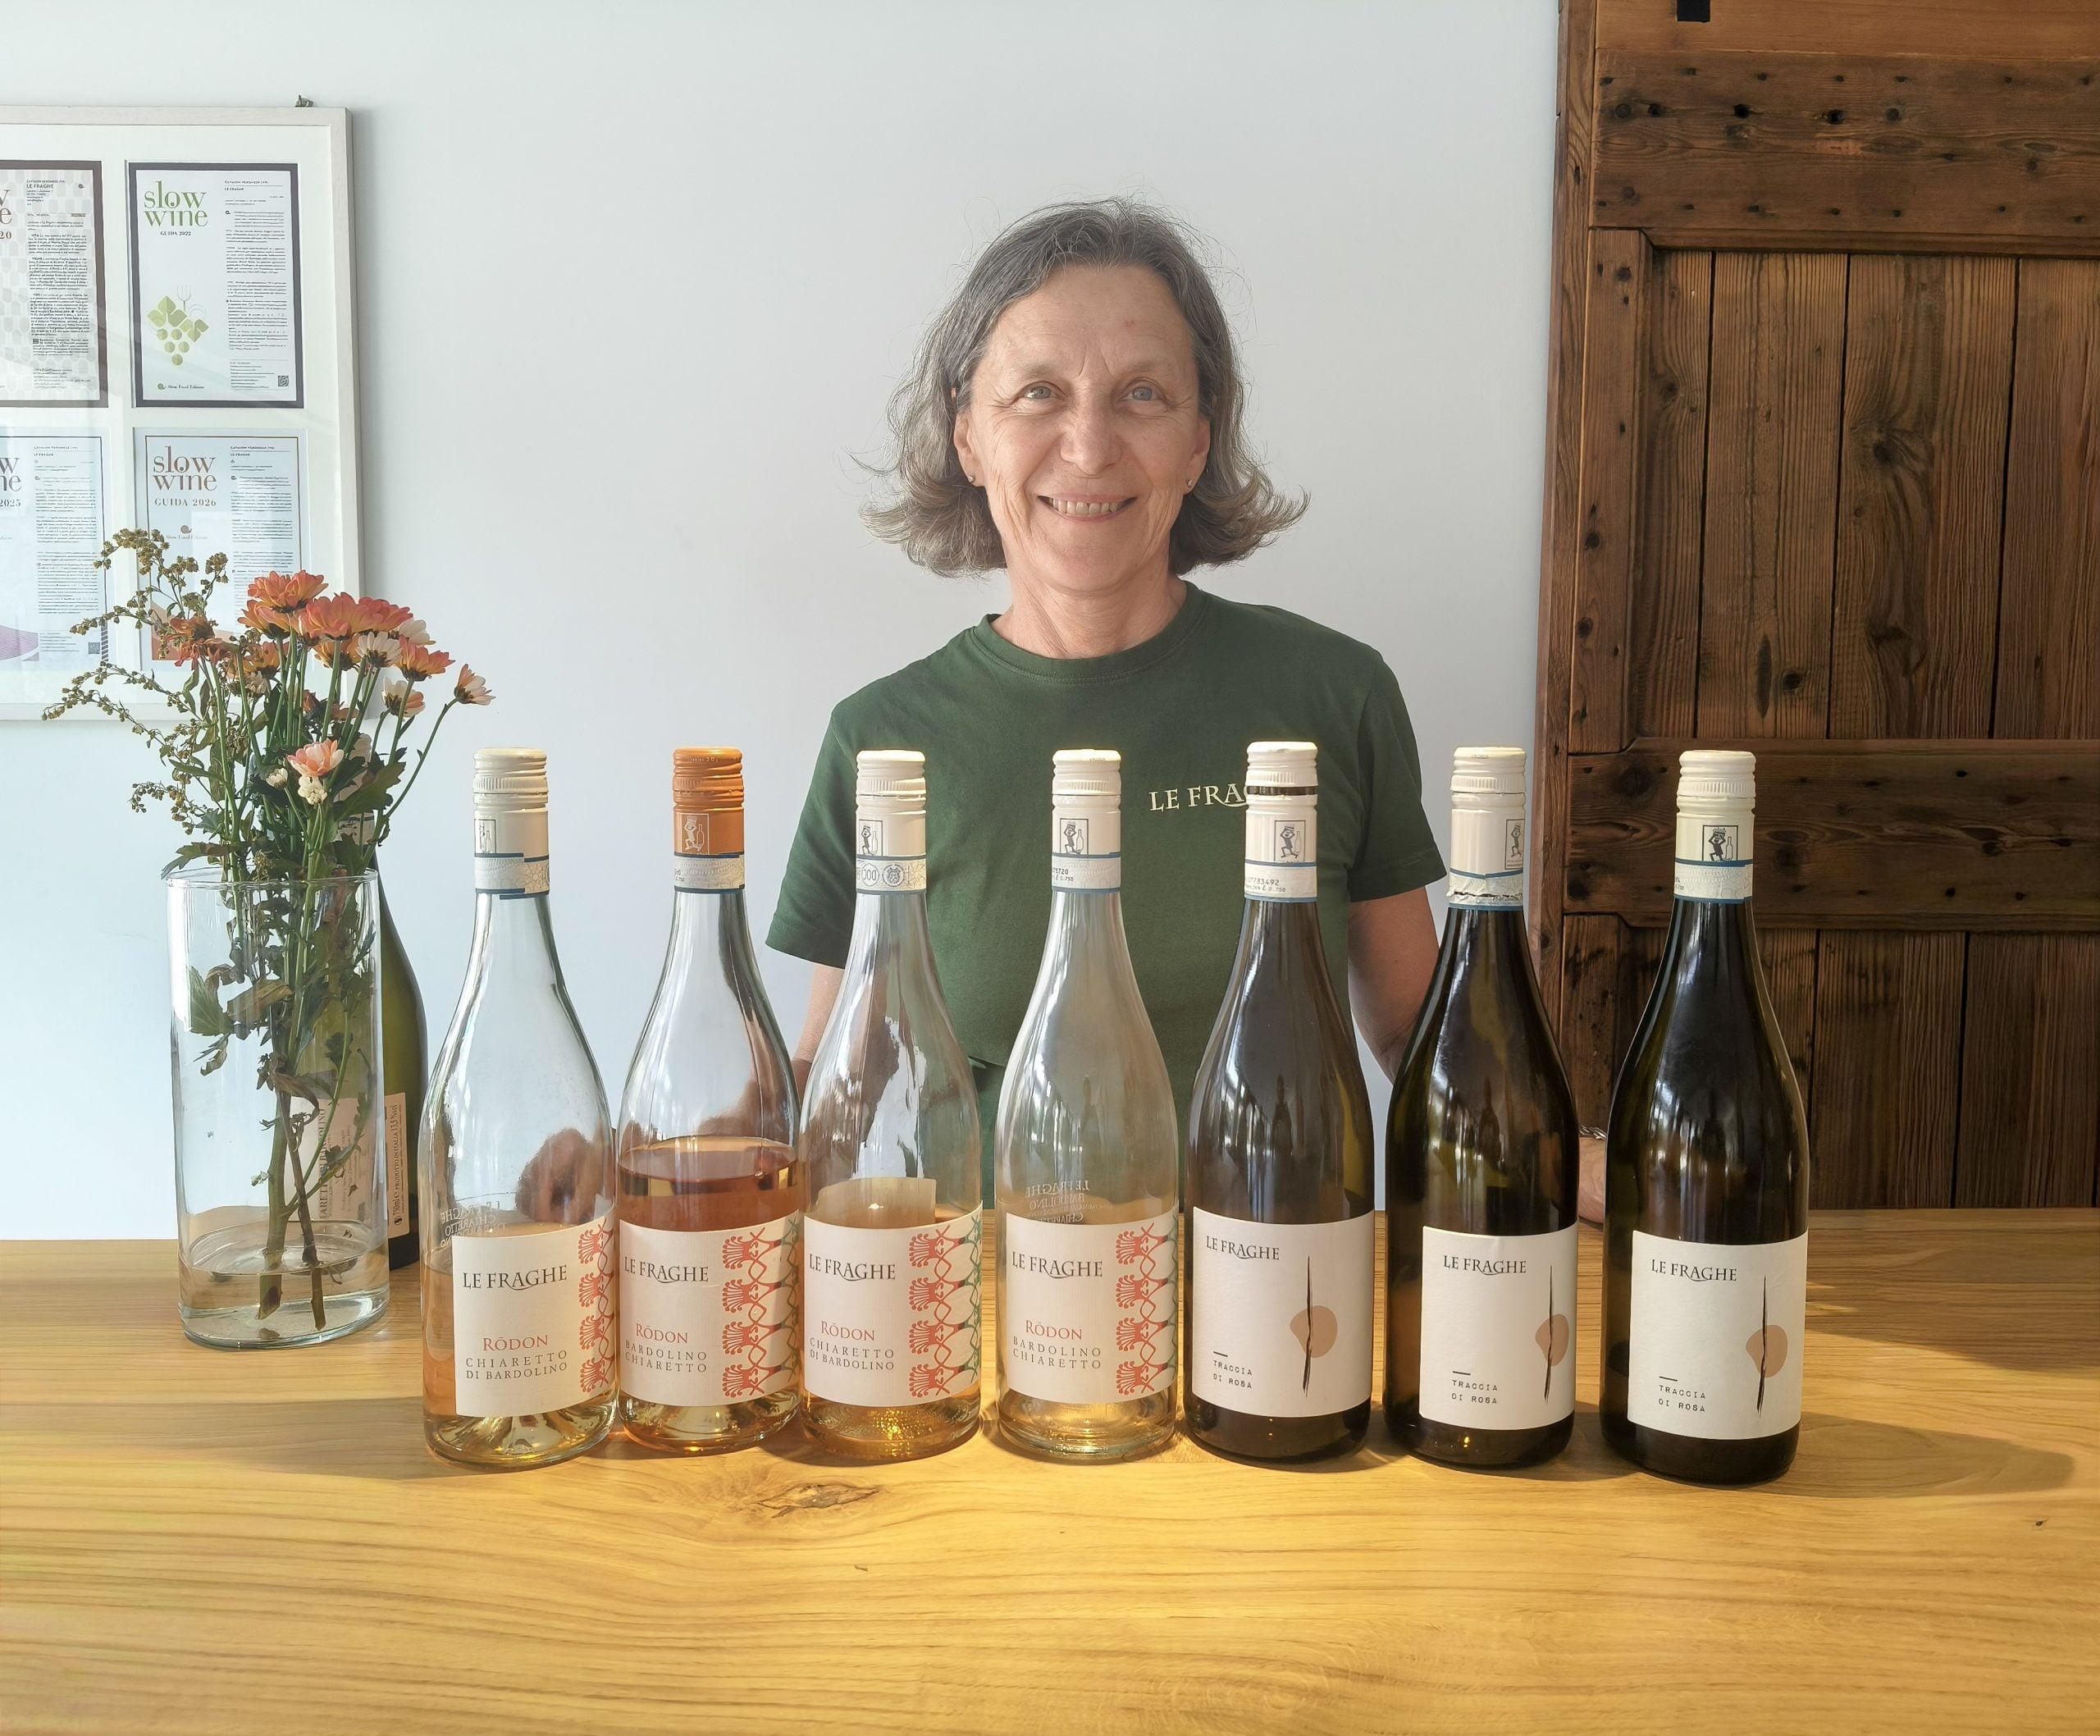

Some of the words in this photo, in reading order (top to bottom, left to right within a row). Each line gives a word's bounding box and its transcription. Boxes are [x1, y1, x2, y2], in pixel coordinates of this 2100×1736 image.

[144, 180, 207, 208] slow
[143, 210, 208, 226] wine
[153, 445, 216, 473] slow
[153, 475, 217, 491] wine
[154, 498, 188, 506] GUIDA
[192, 498, 217, 506] 2026
[1148, 788, 1180, 811] LE
[1187, 783, 1247, 807] FRA
[1207, 1236, 1218, 1250] LE
[1221, 1240, 1280, 1260] FRAGHE
[624, 1257, 636, 1274] LE
[639, 1261, 709, 1284] FRAGHE
[810, 1254, 821, 1272] LE
[825, 1259, 896, 1281] FRAGHE
[1012, 1251, 1025, 1270] LE
[1029, 1256, 1102, 1279] FRAGHE
[1444, 1255, 1459, 1270] LE
[1463, 1258, 1527, 1276] FRAGHE
[1651, 1259, 1666, 1274] LE
[1671, 1263, 1737, 1282] FRAGHE
[463, 1272, 481, 1289] LE
[486, 1264, 567, 1291] FRAGHE
[625, 1339, 706, 1360] BARDOLINO
[810, 1337, 894, 1359] CHIARETTO
[1013, 1336, 1101, 1357] BARDOLINO
[466, 1350, 567, 1368] CHIARETTO
[625, 1351, 706, 1373] CHIARETTO
[810, 1350, 819, 1360] DI
[823, 1354, 894, 1370] BARDOLINO
[1013, 1348, 1101, 1369] CHIARETTO
[1213, 1360, 1253, 1376] TRACCIA
[466, 1370, 478, 1379] DI
[486, 1362, 567, 1380] BARDOLINO
[1213, 1373, 1222, 1382] DI
[1229, 1377, 1253, 1389] ROSA
[1452, 1379, 1498, 1391] TRACCIA
[1659, 1385, 1705, 1399] TRACCIA
[1451, 1393, 1463, 1401] DI
[1472, 1396, 1497, 1405] ROSA
[1659, 1398, 1669, 1407] DI
[1678, 1401, 1705, 1413] ROSA
